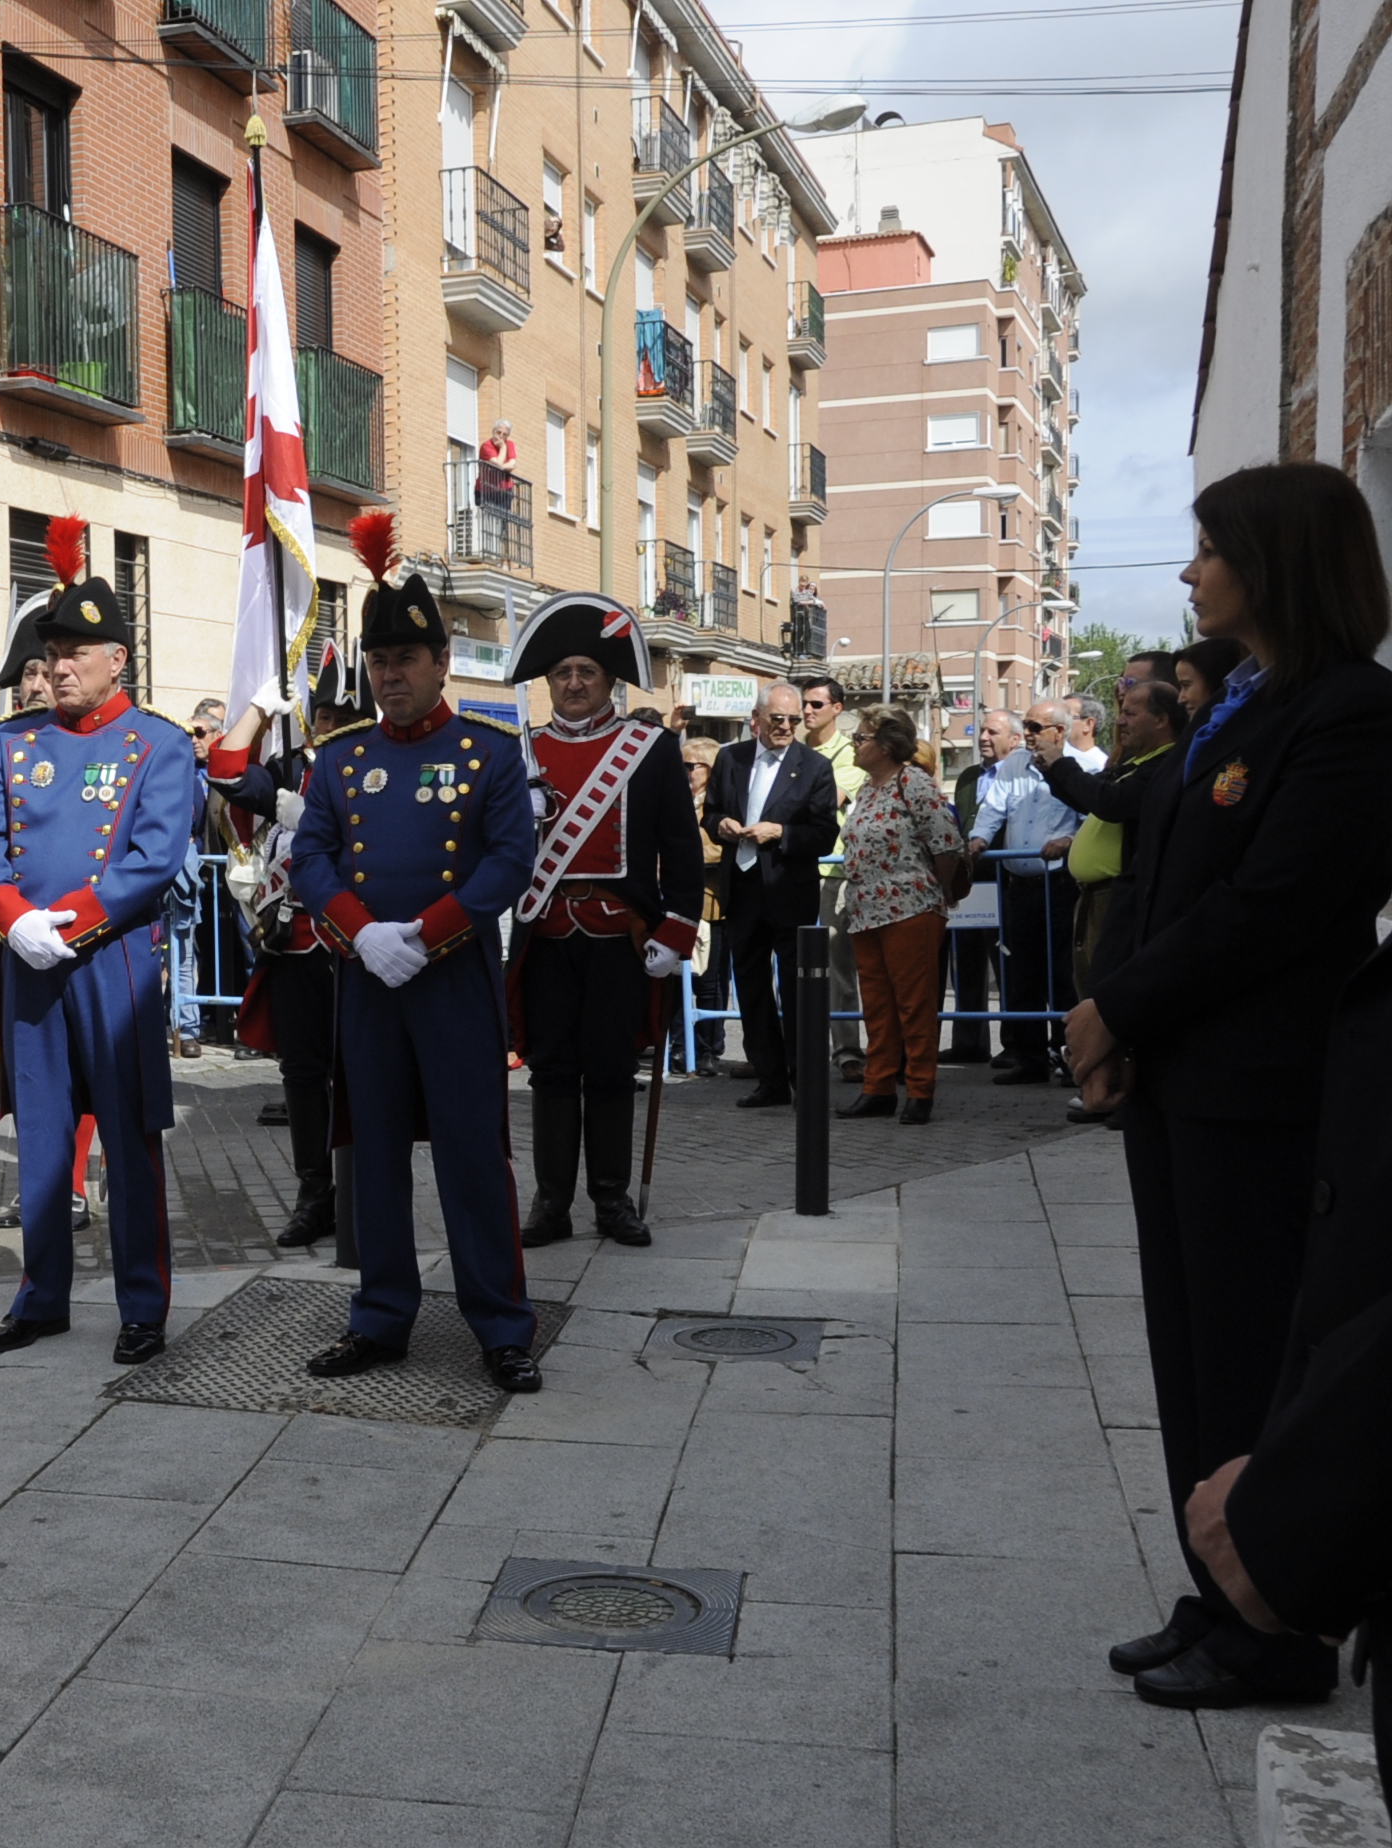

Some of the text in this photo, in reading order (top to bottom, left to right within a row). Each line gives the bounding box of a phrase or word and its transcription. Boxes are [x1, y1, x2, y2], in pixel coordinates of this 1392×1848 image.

[702, 679, 754, 698] TABERNA
[706, 700, 753, 712] EL PASO
